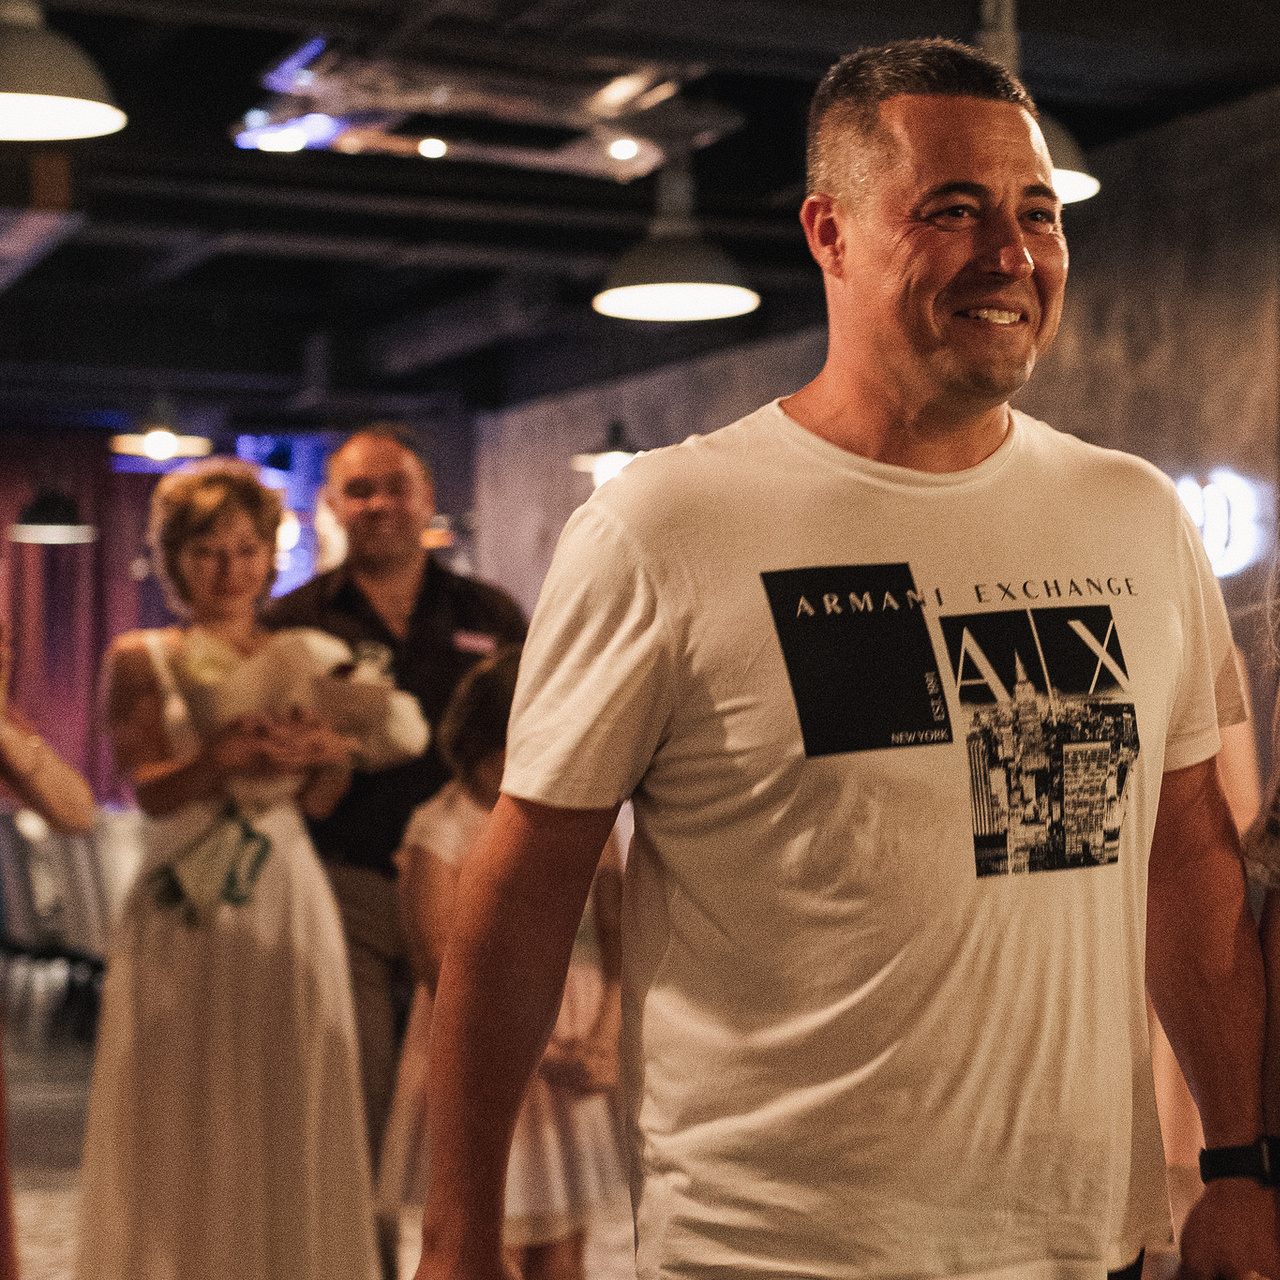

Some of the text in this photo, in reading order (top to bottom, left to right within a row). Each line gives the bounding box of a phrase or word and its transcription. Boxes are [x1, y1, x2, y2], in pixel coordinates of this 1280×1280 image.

[796, 576, 1139, 618] ARMANI EXCHANGE
[891, 727, 949, 745] NEW YORK
